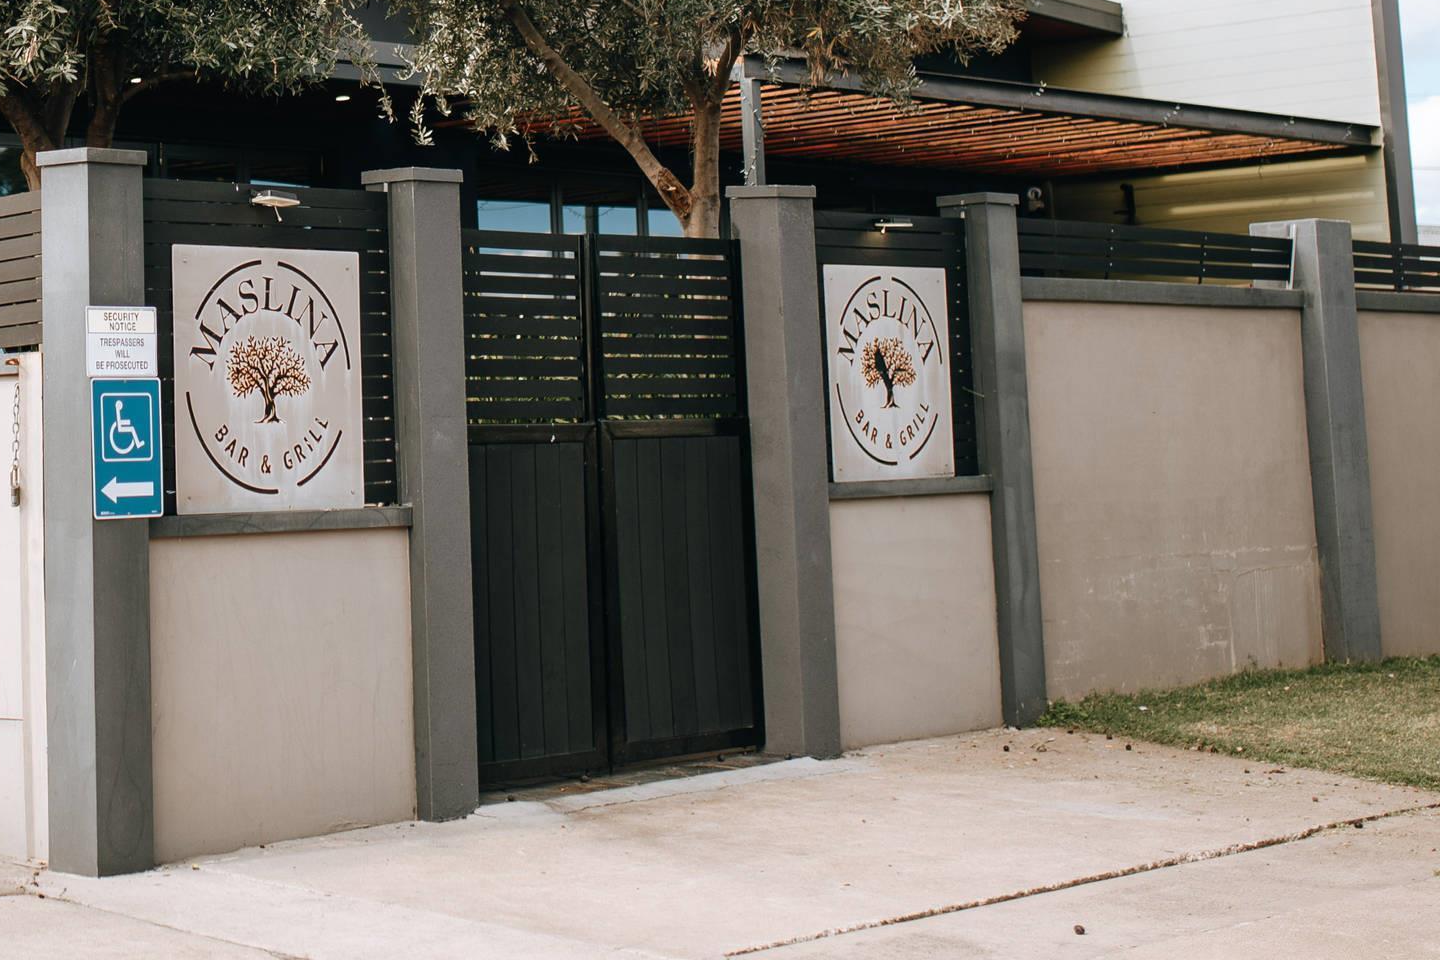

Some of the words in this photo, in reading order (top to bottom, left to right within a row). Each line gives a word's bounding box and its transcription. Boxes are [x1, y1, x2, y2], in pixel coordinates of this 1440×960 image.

[103, 312, 140, 321] SECURITY
[109, 322, 137, 331] NOTICE
[189, 276, 339, 371] MASLINA
[837, 290, 934, 365] MASLINA
[100, 338, 145, 347] TRESPASSERS
[114, 349, 131, 358] WILL
[96, 361, 105, 370] BE
[106, 361, 149, 370] PROSECUTED
[855, 409, 878, 445] BAR
[885, 434, 893, 449] &
[899, 402, 929, 446] GRILL
[215, 424, 250, 468] BAR
[261, 454, 272, 474] &
[283, 417, 329, 470] GRILL
